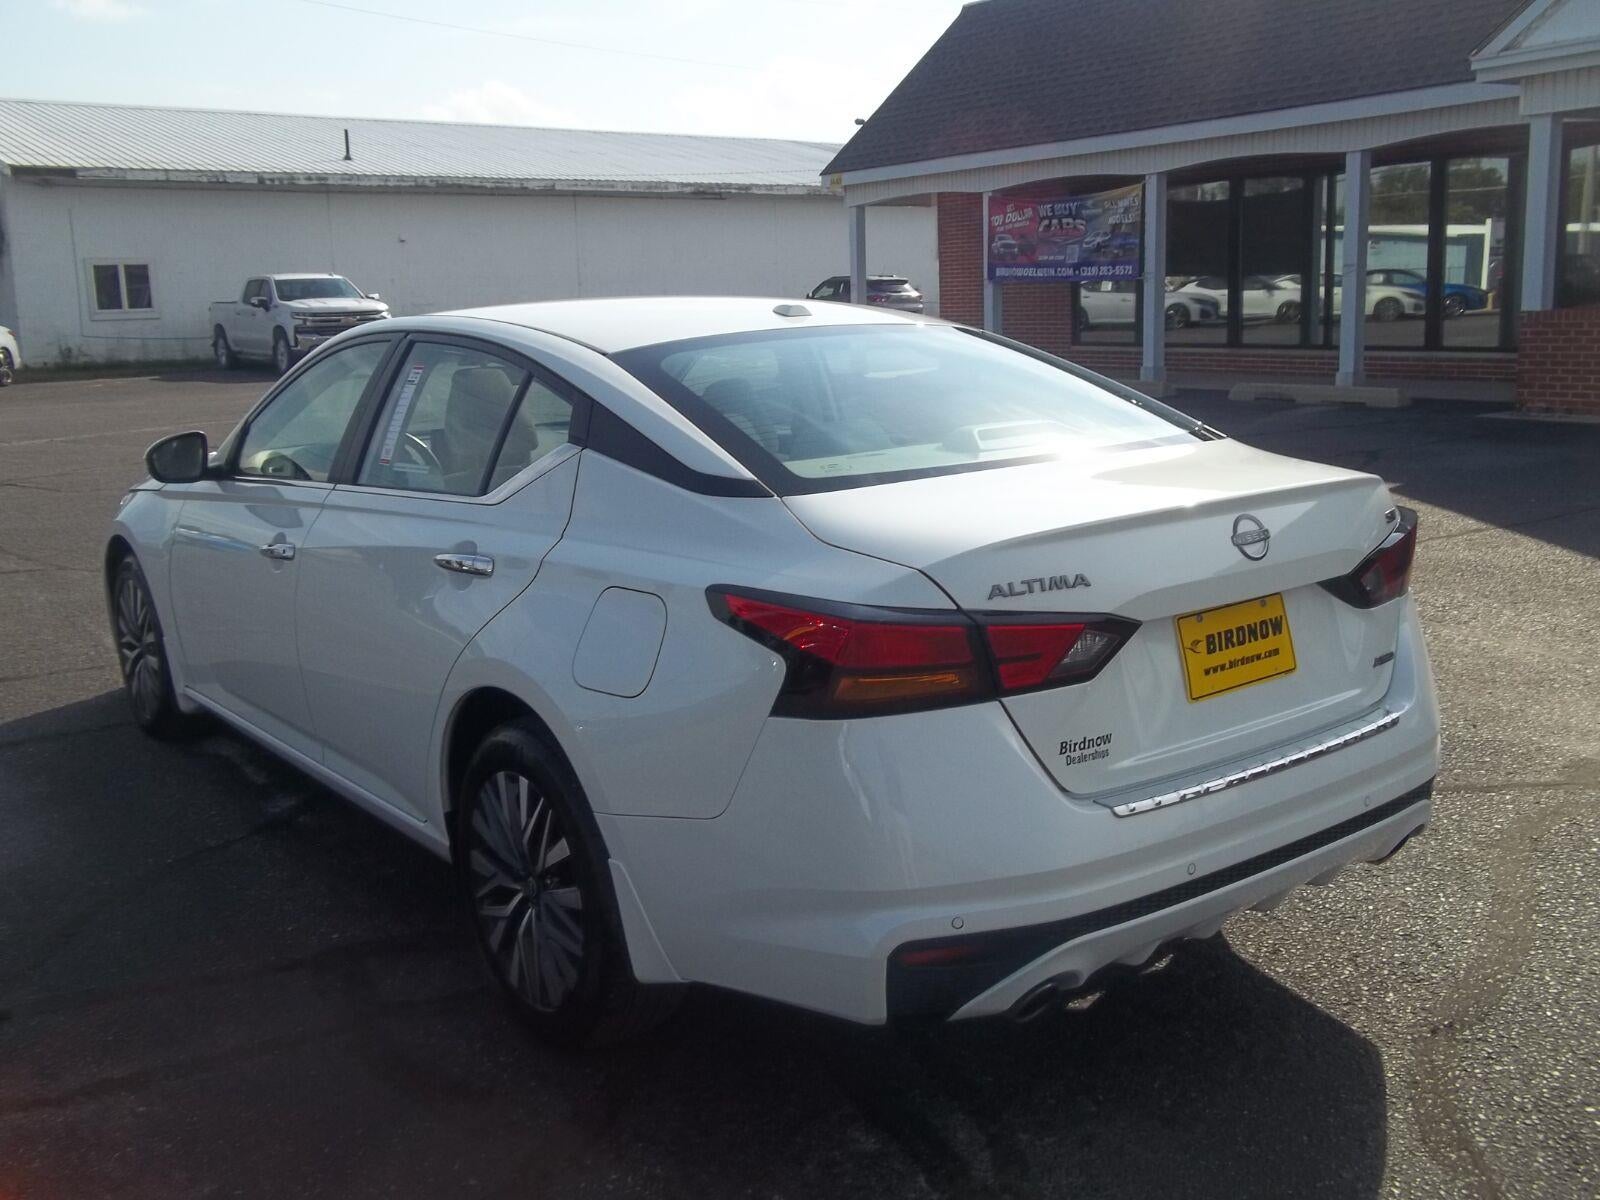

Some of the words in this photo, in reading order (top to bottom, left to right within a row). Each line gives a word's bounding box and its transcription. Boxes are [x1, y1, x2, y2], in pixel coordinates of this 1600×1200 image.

[1038, 203, 1053, 217] WE
[1038, 217, 1087, 232] CARS
[987, 573, 1092, 601] ALTIMA
[1205, 614, 1283, 655] BIRDNOW
[1203, 647, 1280, 676] www.birdnow.com
[1059, 732, 1113, 756] Birdnow
[1065, 748, 1110, 767] Dealerships
